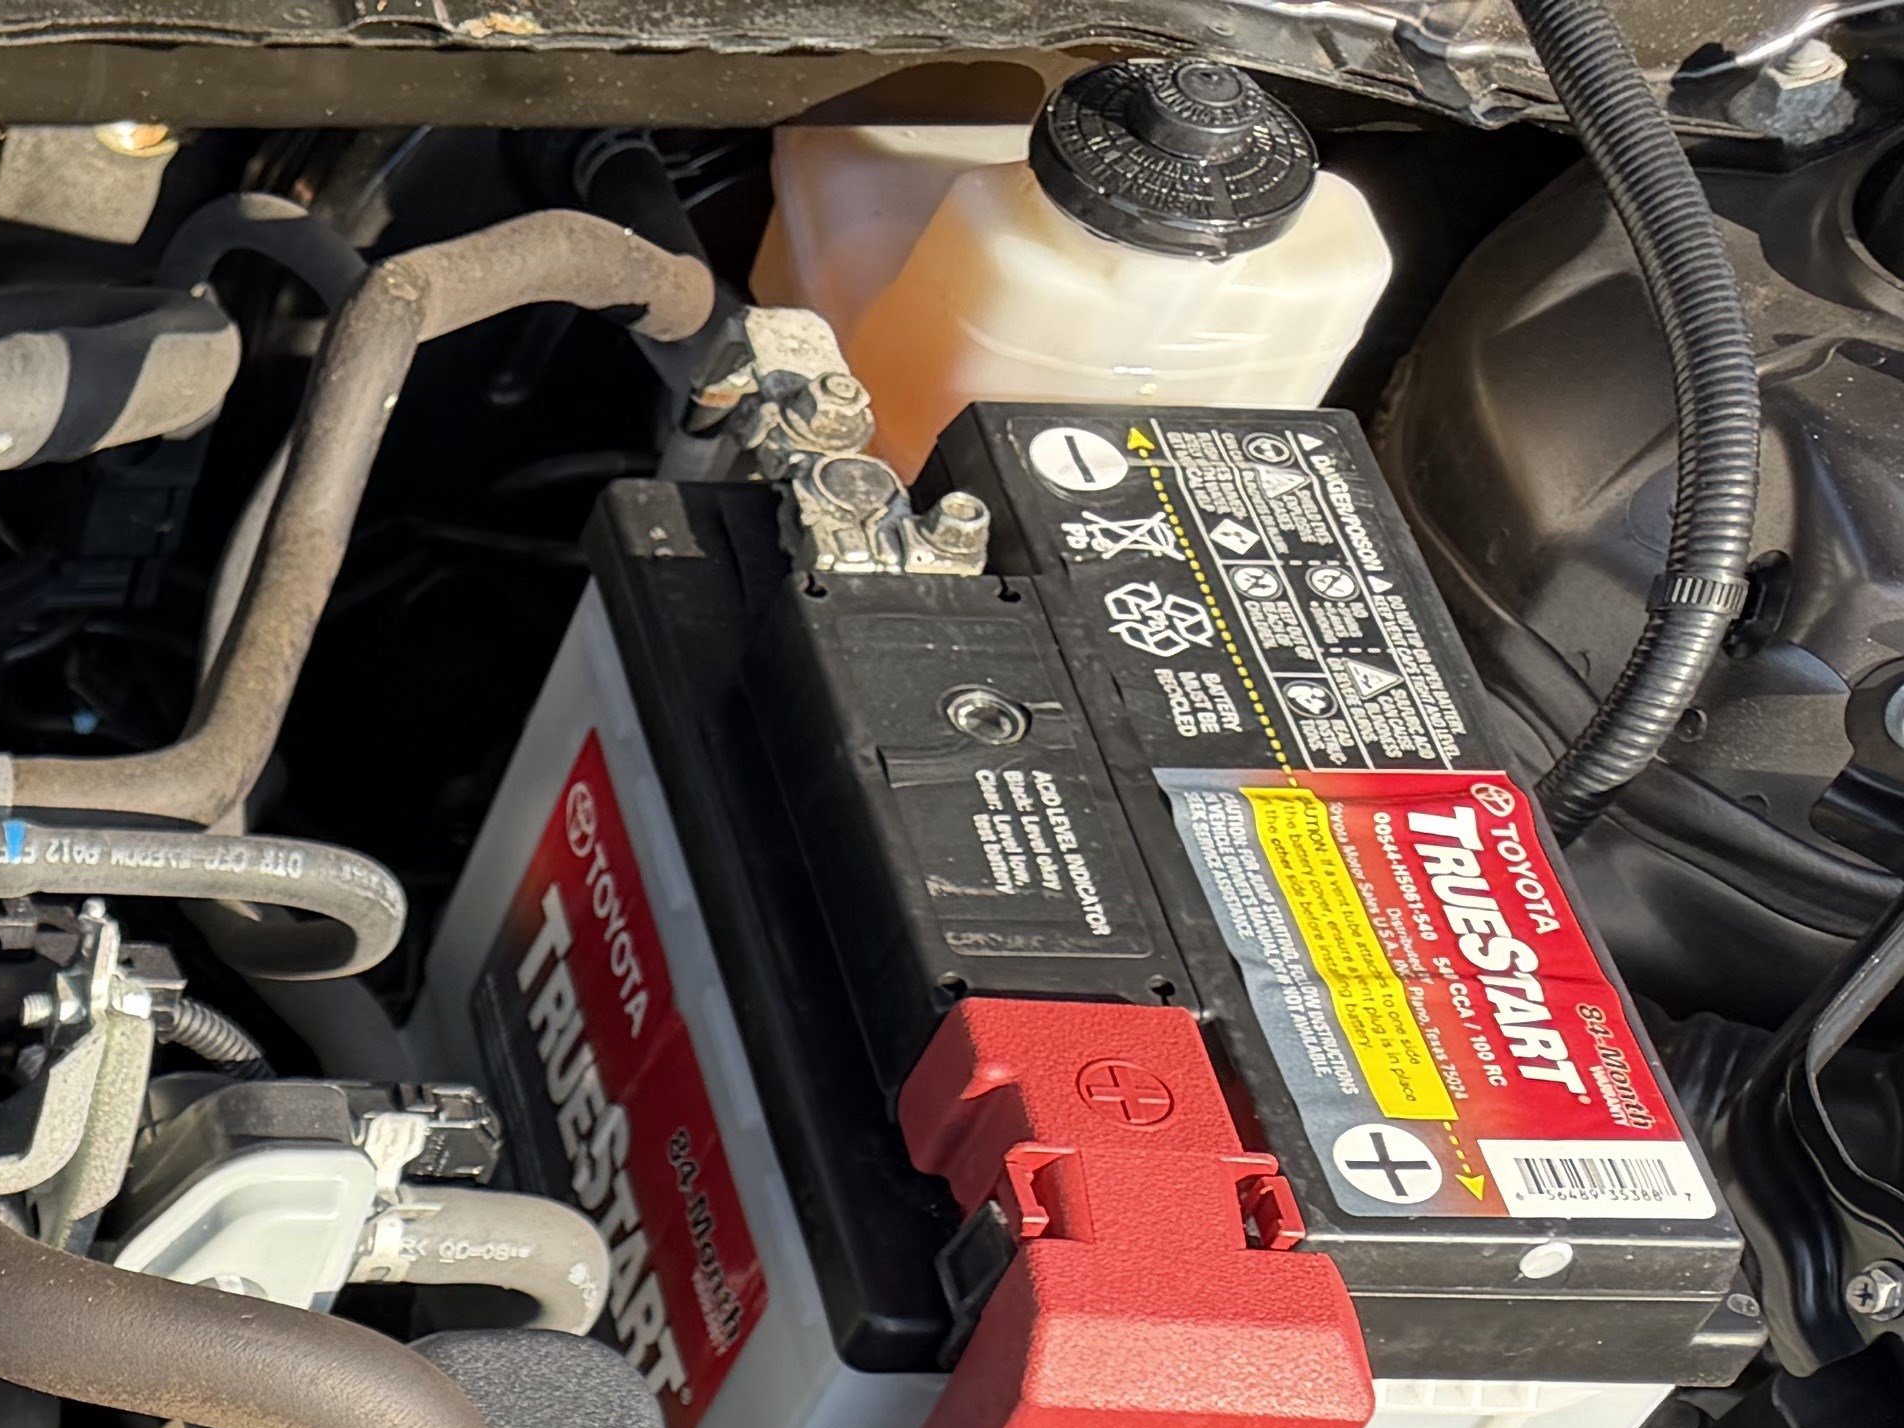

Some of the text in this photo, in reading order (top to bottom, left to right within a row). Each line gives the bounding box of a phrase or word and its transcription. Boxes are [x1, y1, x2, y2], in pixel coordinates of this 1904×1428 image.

[1310, 454, 1382, 571] DANGER/POISON
[1060, 522, 1094, 549] Pb
[1140, 608, 1171, 631] Pb
[1154, 668, 1197, 736] RECYCLED
[1178, 671, 1220, 732] MUST BE
[1201, 672, 1242, 731] BATTERY
[1183, 791, 1213, 821] SEEK
[1265, 809, 1278, 834] the
[1282, 805, 1298, 829] the
[975, 769, 1030, 885] Clear: Level low,
[1002, 770, 1061, 890] Black: Level okay
[1191, 821, 1227, 868] SERVICE
[972, 813, 1014, 894] test battery
[1031, 770, 1110, 934] ACID LEVEL INDICATOR
[1237, 848, 1260, 870] FOR
[1270, 837, 1292, 870] other
[1288, 833, 1315, 876] battery
[1246, 871, 1275, 903] JUMP
[1285, 873, 1305, 897] side
[1308, 879, 1332, 917] cover,
[1329, 879, 1350, 906] vent
[1491, 823, 1559, 933] TOYOTA
[1198, 802, 1243, 853] VEHICLE
[1246, 906, 1279, 956] MANUAL
[1282, 985, 1309, 1013] NOT
[1298, 901, 1325, 940] before
[1341, 910, 1362, 937] tube
[584, 854, 649, 1038] TOYOTA
[1326, 920, 1354, 962] ensure
[1342, 845, 1365, 879] Motor
[1357, 882, 1380, 913] Sales
[1425, 1026, 1448, 1060] Texas
[1386, 907, 1426, 971] Distributed
[1287, 963, 1321, 1009] FOLLOW
[1381, 993, 1395, 1008] to
[1362, 1006, 1386, 1034] plug
[1387, 1010, 1406, 1035] one
[1449, 982, 1475, 1018] CCA
[1470, 1035, 1495, 1061] 100
[1483, 1064, 1507, 1086] RC
[1307, 1010, 1358, 1094] INSTRUCTIONS
[1379, 1037, 1393, 1048] is
[1385, 1051, 1400, 1064] in
[1399, 1038, 1420, 1064] side
[1389, 1067, 1416, 1101] place
[1575, 1003, 1655, 1129] 84-Month
